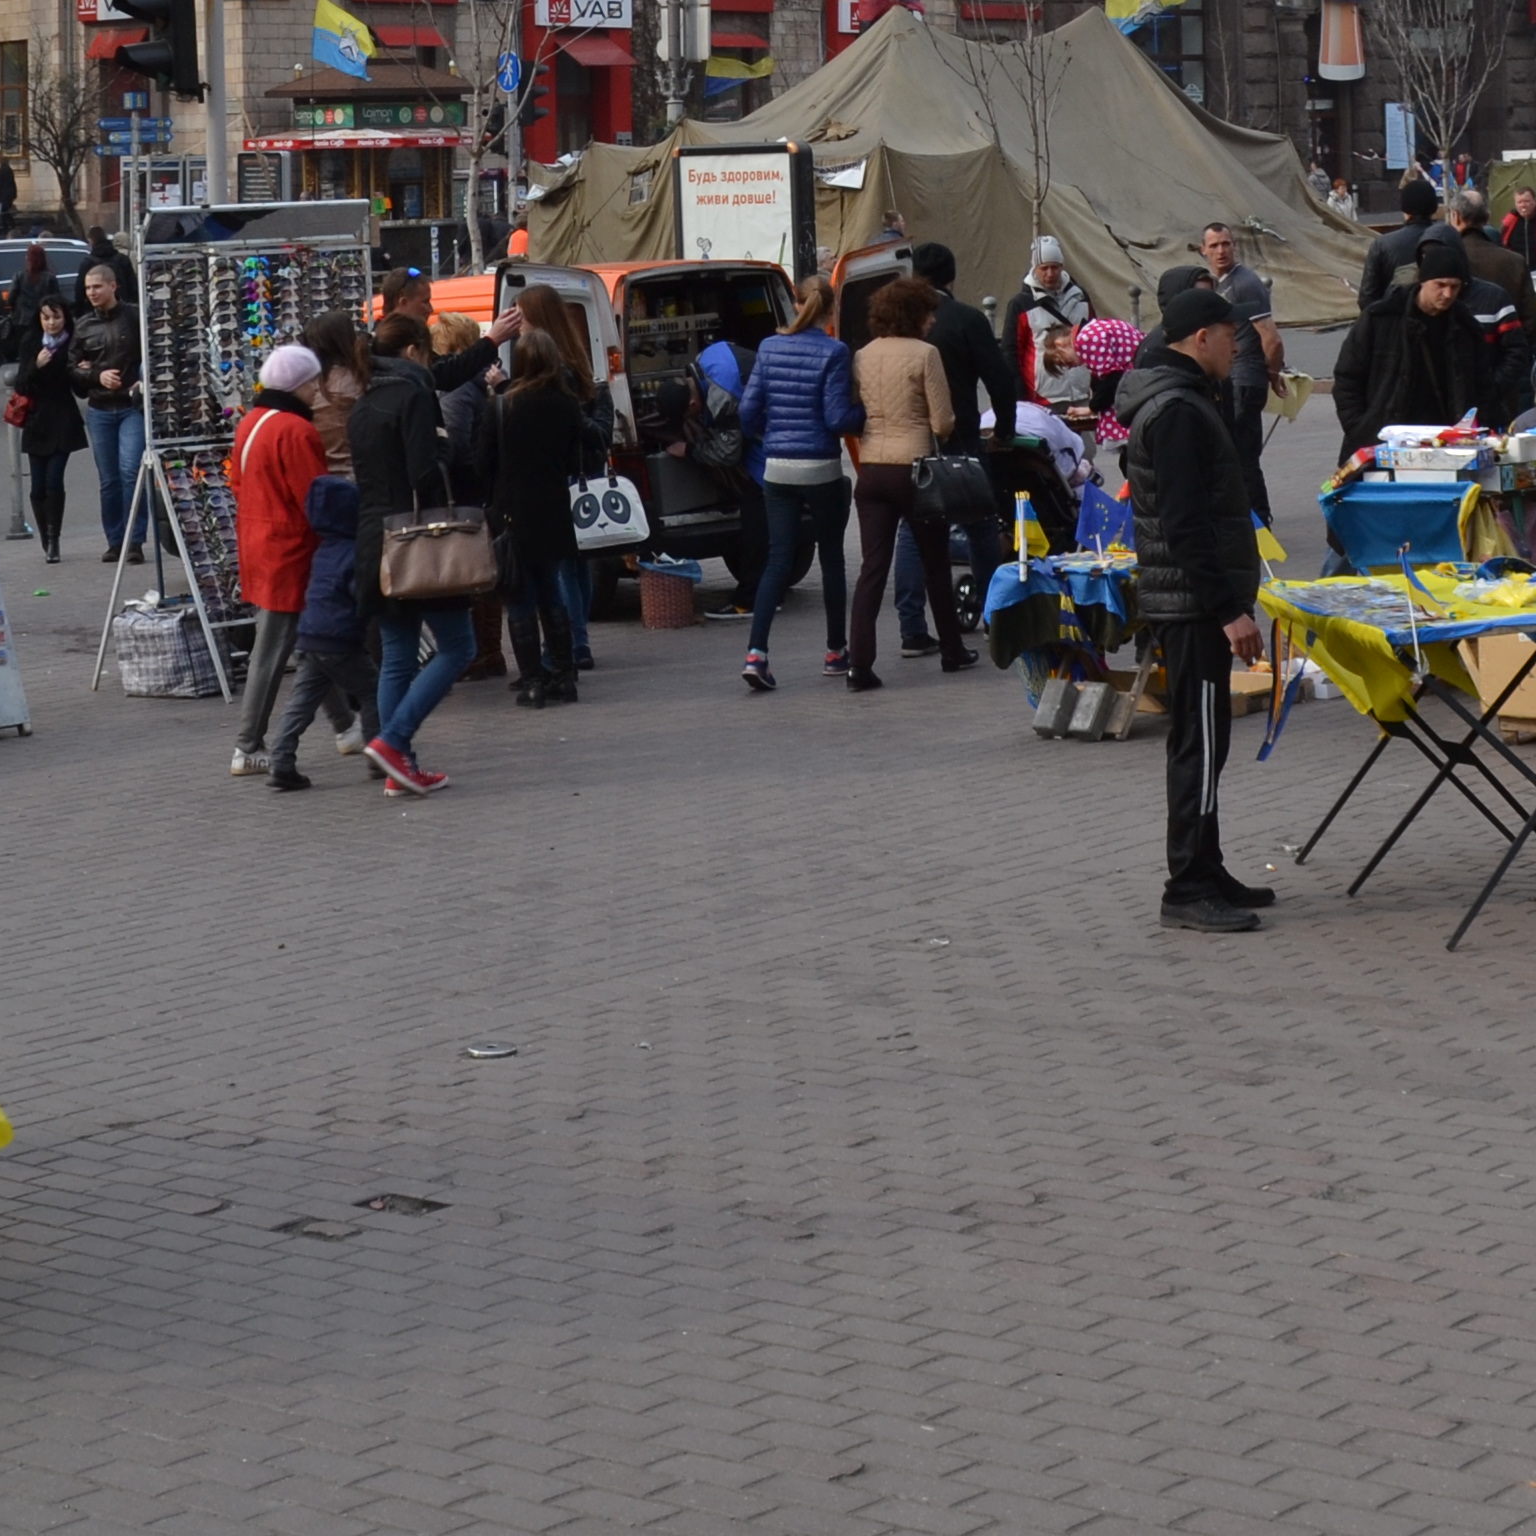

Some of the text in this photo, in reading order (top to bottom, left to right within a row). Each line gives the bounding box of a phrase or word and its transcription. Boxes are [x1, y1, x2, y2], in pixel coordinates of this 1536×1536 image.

[573, 0, 623, 19] VAB
[688, 168, 784, 186] Будь здоровим,
[696, 190, 776, 206] живи довше!
